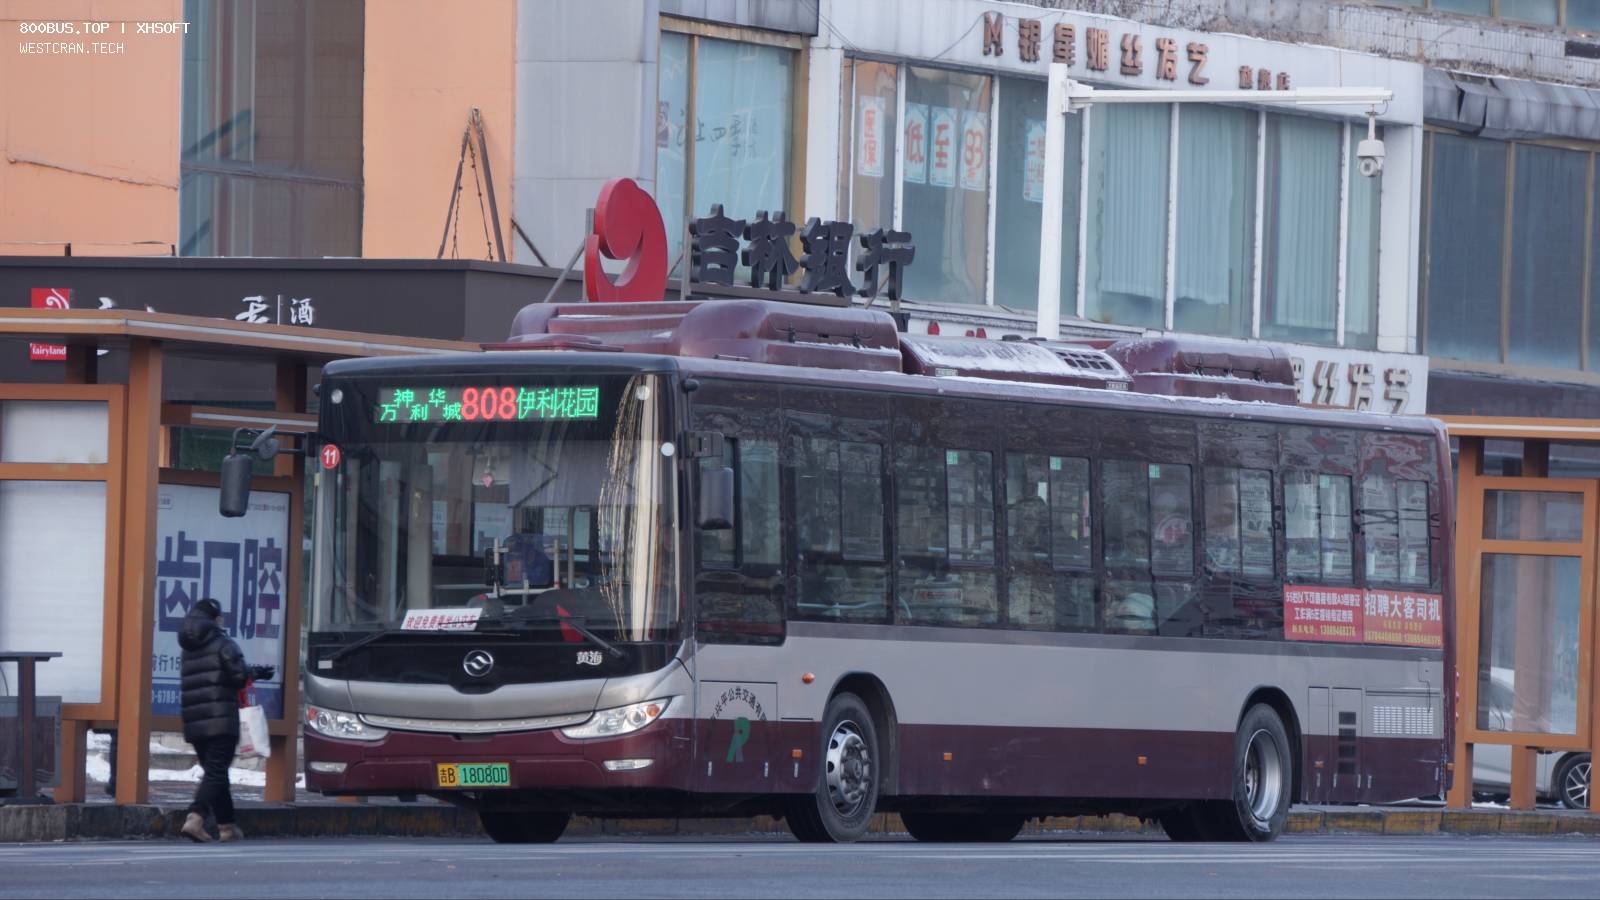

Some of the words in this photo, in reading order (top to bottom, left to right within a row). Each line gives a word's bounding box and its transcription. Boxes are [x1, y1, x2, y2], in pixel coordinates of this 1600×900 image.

[689, 203, 916, 301] 吉林银行
[32, 345, 67, 357] fairyland
[461, 386, 517, 421] 808
[516, 387, 599, 420] 伊利花园
[323, 450, 336, 465] 11
[1364, 593, 1441, 622] 招聘大客司机
[576, 650, 603, 667] 黄海
[439, 767, 456, 784] 吉B
